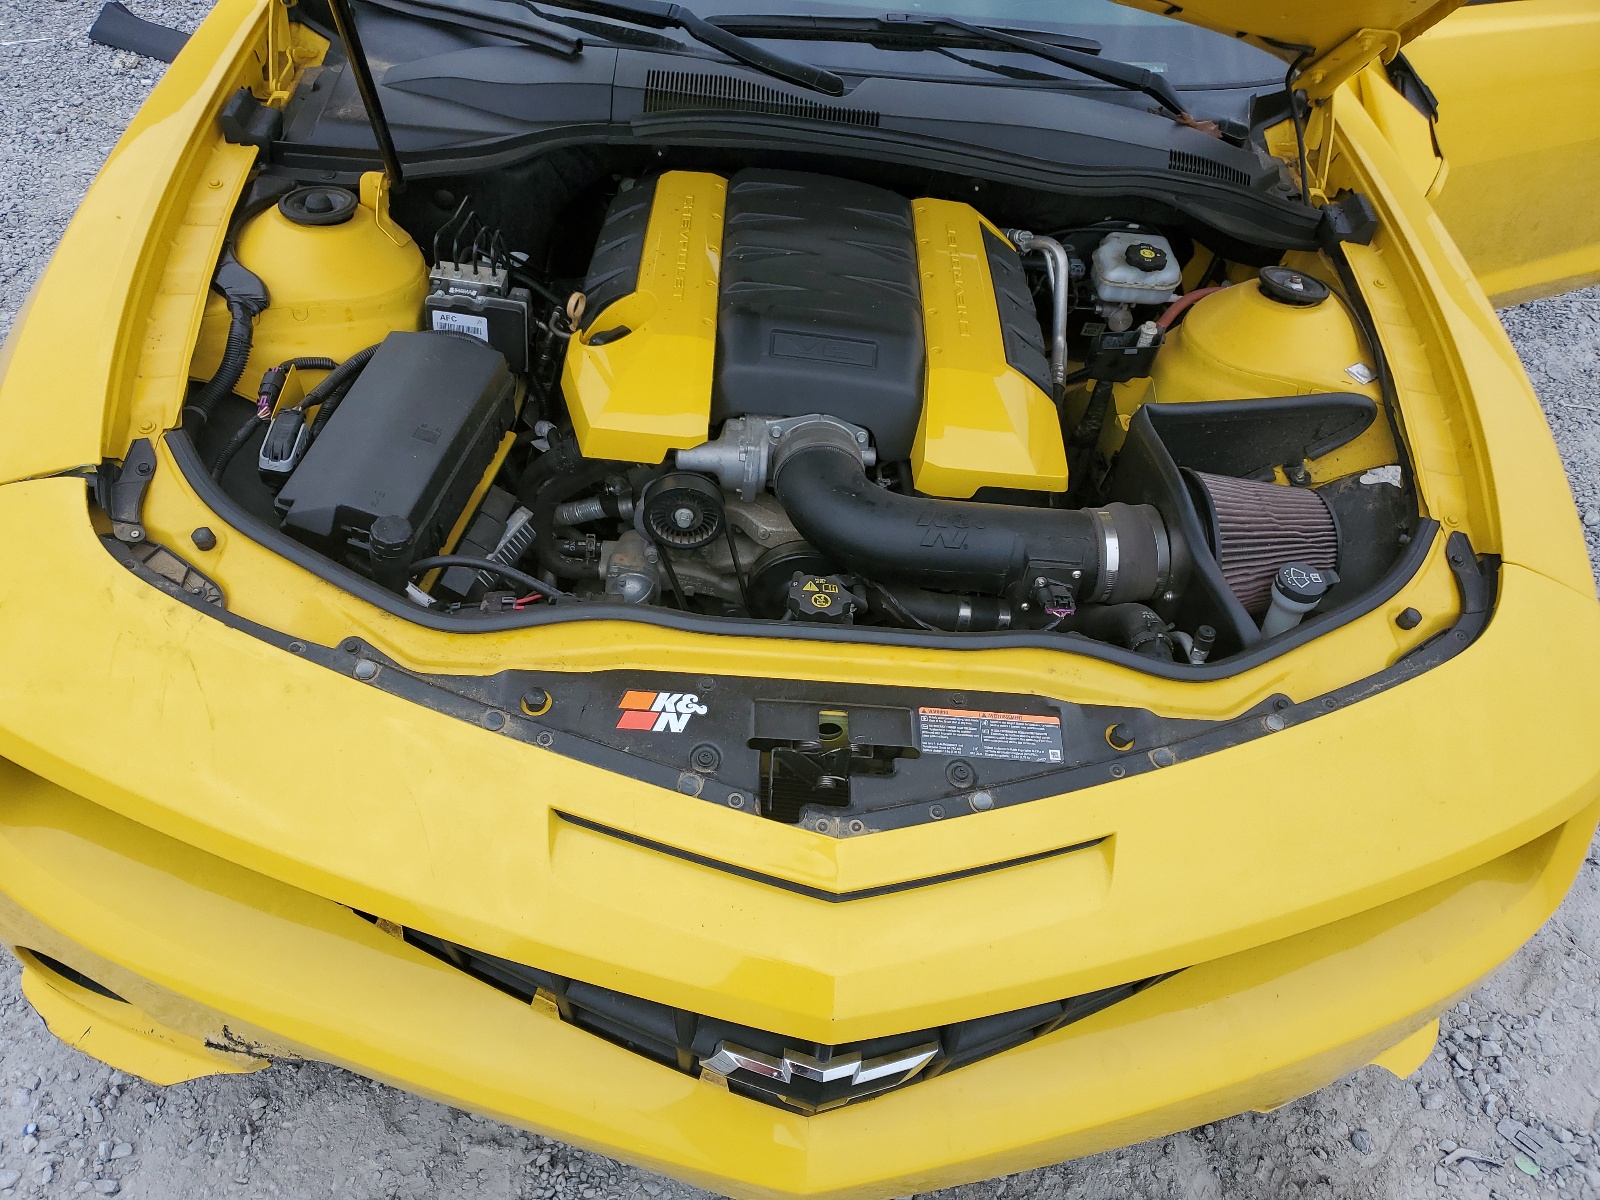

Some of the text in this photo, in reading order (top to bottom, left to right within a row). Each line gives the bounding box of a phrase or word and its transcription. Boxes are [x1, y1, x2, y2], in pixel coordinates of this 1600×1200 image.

[672, 195, 694, 302] CHEVROLET
[945, 223, 971, 338] CHEVROLET
[439, 314, 458, 322] AFC
